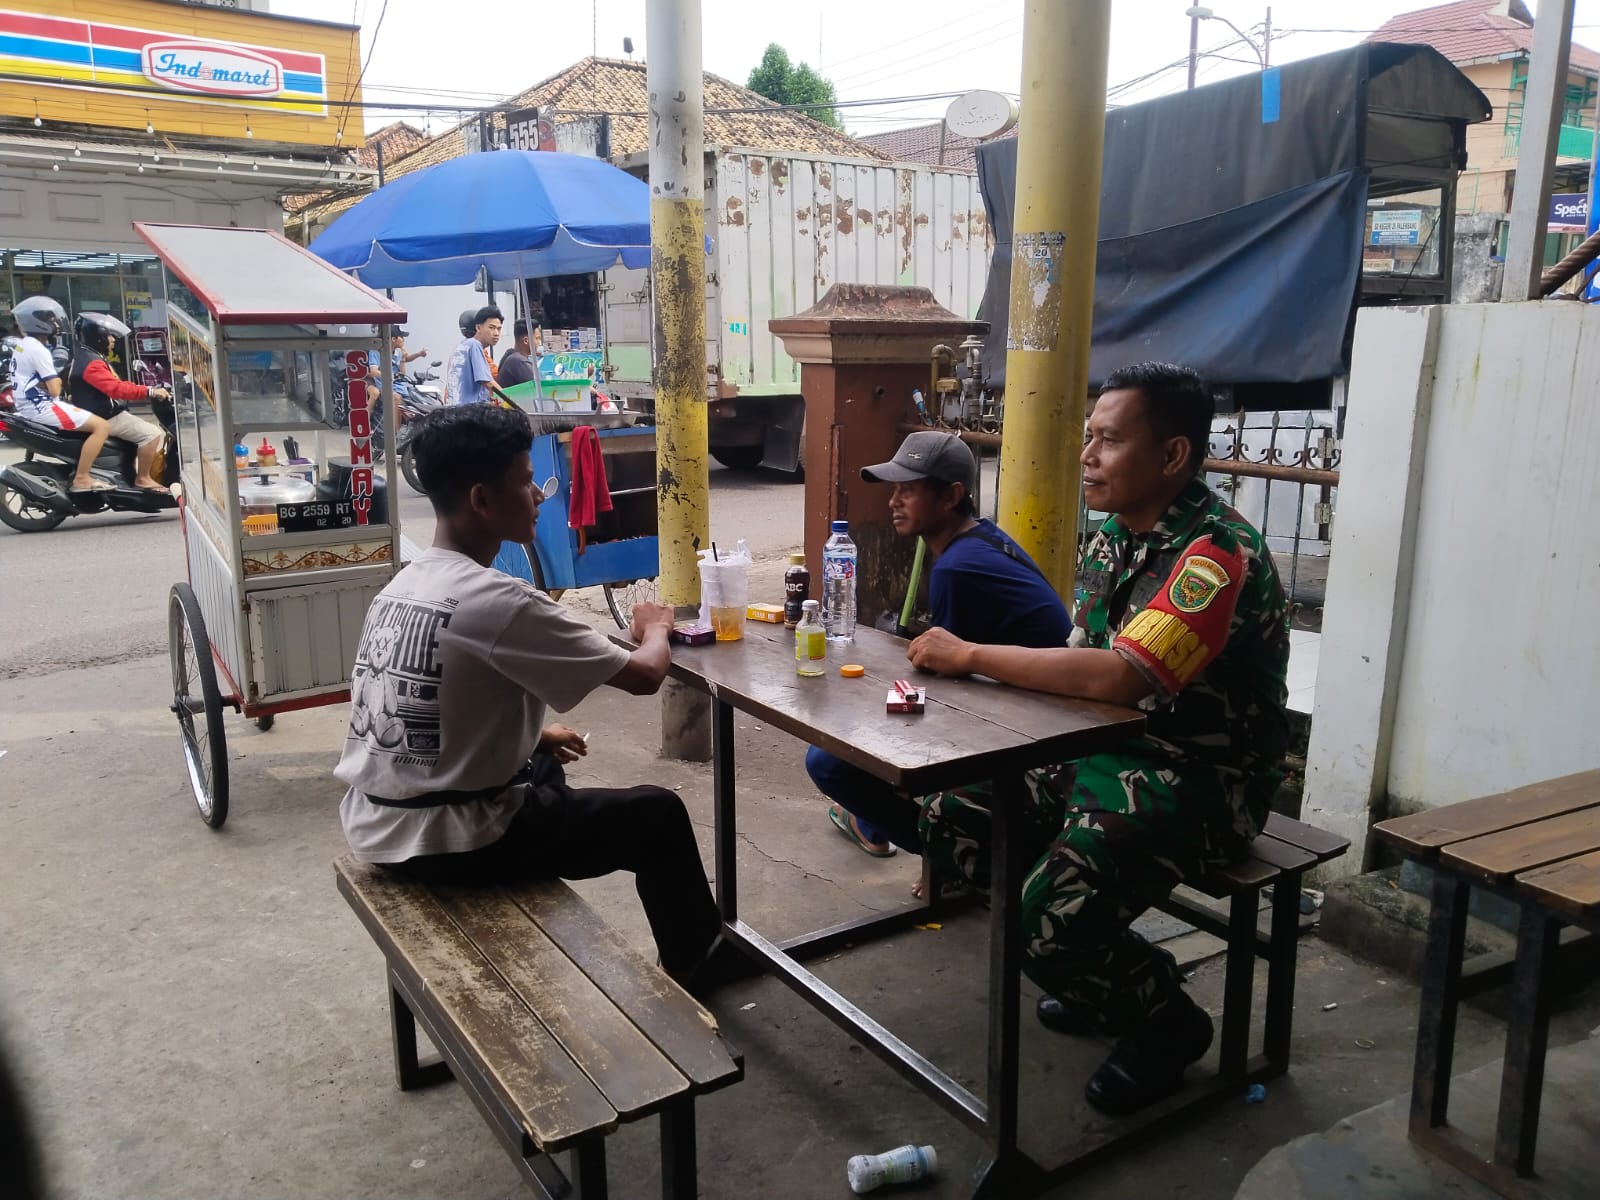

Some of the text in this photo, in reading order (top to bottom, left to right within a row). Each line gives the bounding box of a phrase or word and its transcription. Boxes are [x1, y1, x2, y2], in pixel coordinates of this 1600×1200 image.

[155, 53, 270, 86] Indomaret
[509, 119, 539, 151] 555
[345, 350, 374, 526] SIOMAY
[279, 502, 351, 518] BG 2559 RT
[784, 583, 803, 592] ABC
